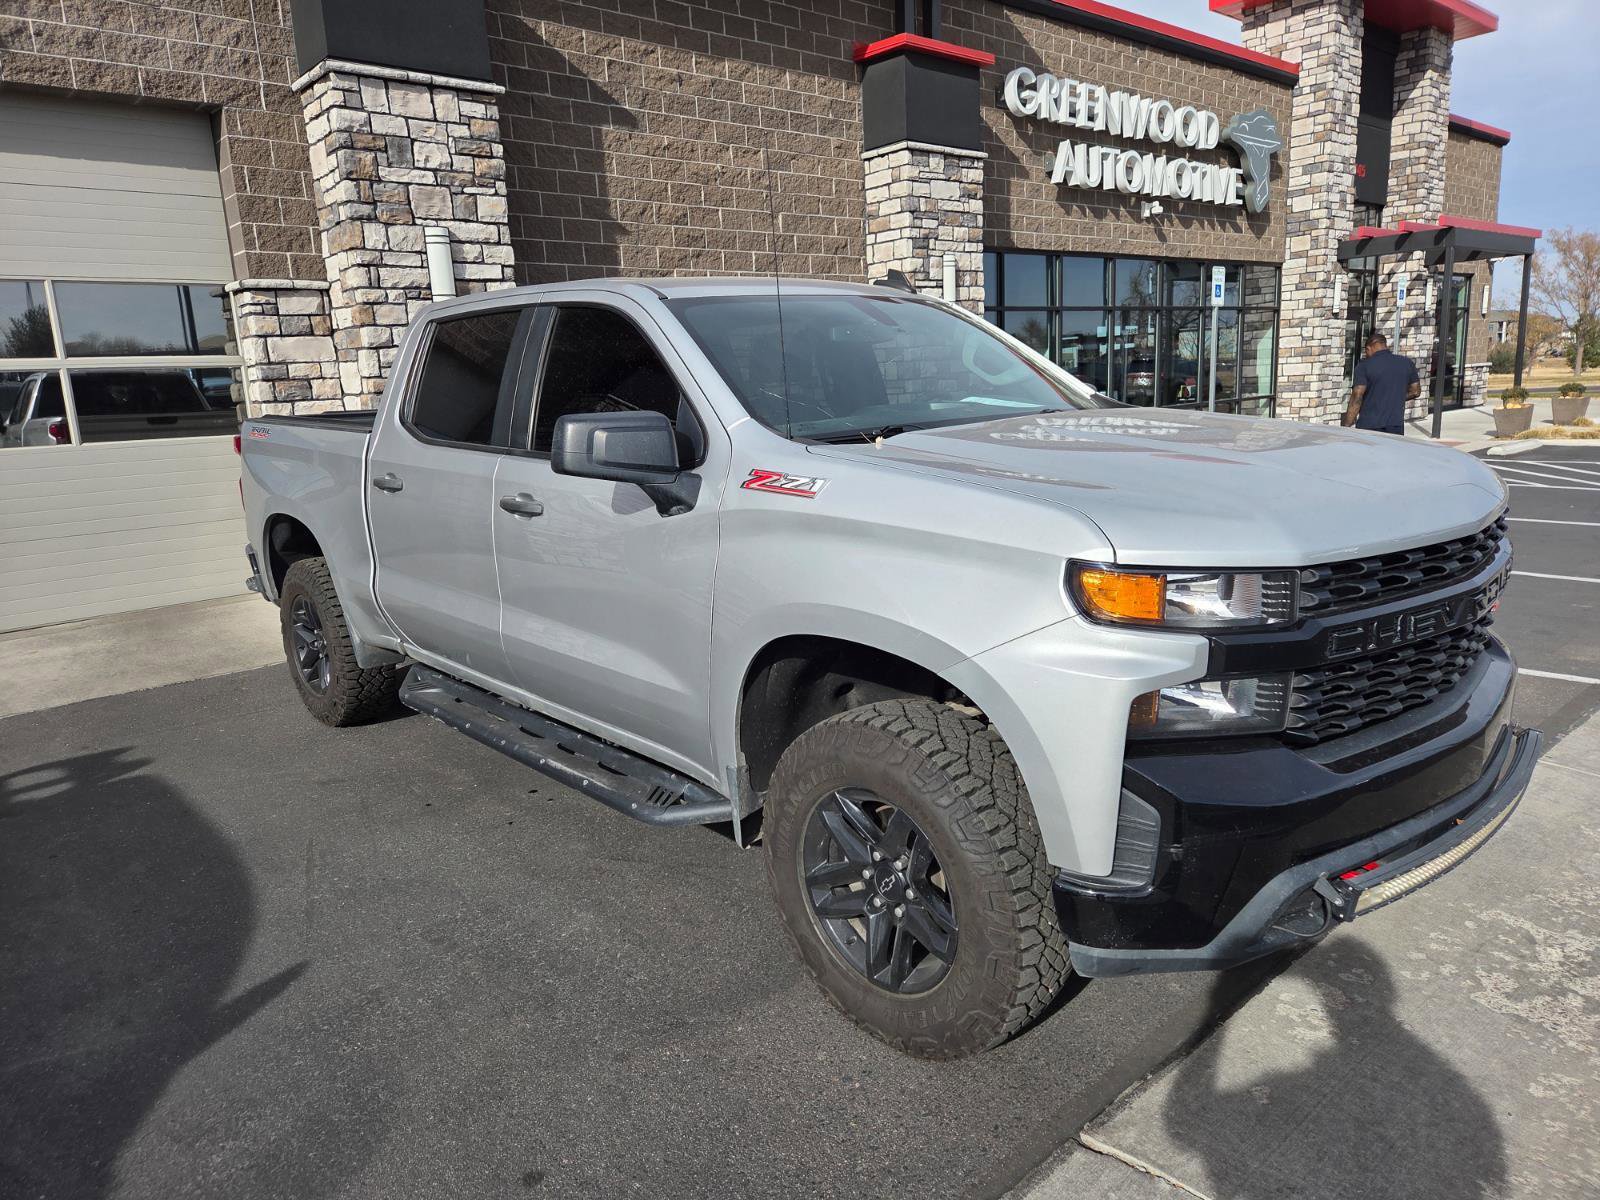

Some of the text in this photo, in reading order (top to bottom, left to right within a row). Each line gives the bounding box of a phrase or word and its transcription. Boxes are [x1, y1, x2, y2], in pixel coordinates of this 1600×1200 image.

[1003, 67, 1220, 150] GREENWOOD
[1050, 138, 1244, 206] AUTOMOTIVE
[740, 468, 831, 499] Z71
